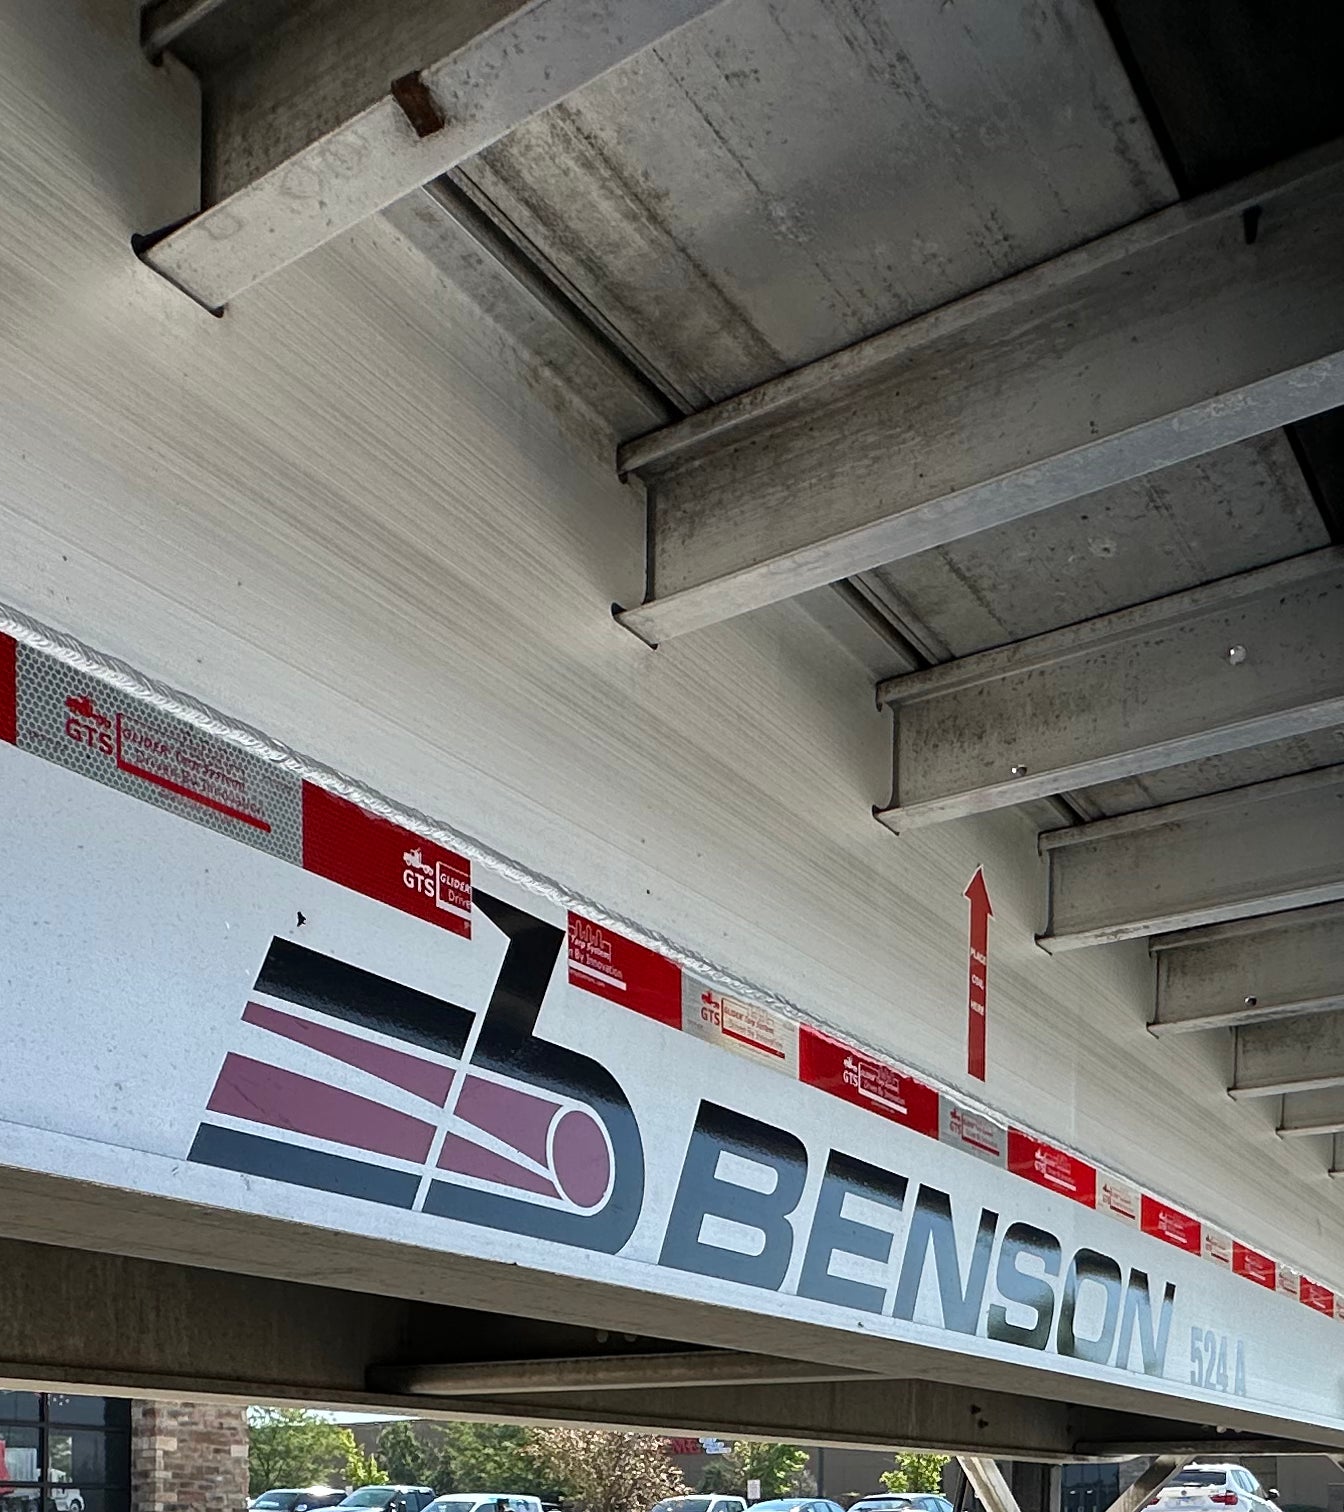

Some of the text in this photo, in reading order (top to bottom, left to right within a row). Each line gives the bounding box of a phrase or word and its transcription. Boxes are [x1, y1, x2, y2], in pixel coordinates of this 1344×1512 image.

[65, 717, 113, 756] GTS
[403, 869, 435, 897] GTS
[701, 1006, 720, 1026] GTS
[843, 1069, 859, 1088] GTS
[657, 1098, 1175, 1379] BENSON
[1190, 1326, 1246, 1397] 524 A
